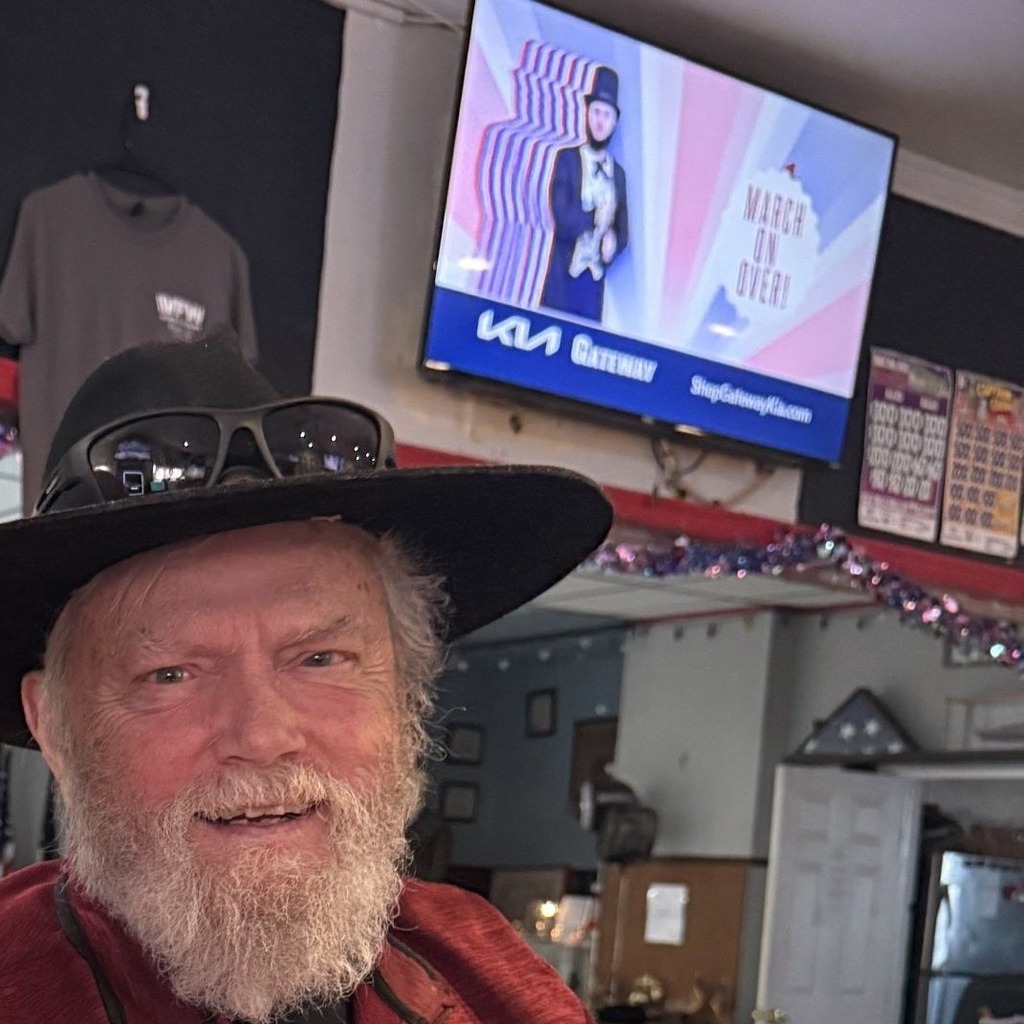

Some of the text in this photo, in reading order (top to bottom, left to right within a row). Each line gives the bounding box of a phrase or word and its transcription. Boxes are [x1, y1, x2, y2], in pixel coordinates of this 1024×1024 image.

[743, 183, 807, 238] MARCH
[753, 227, 780, 268] ON
[736, 259, 791, 311] OVER!
[477, 309, 563, 356] KIA
[690, 374, 813, 424] ShopGatewayKia.com
